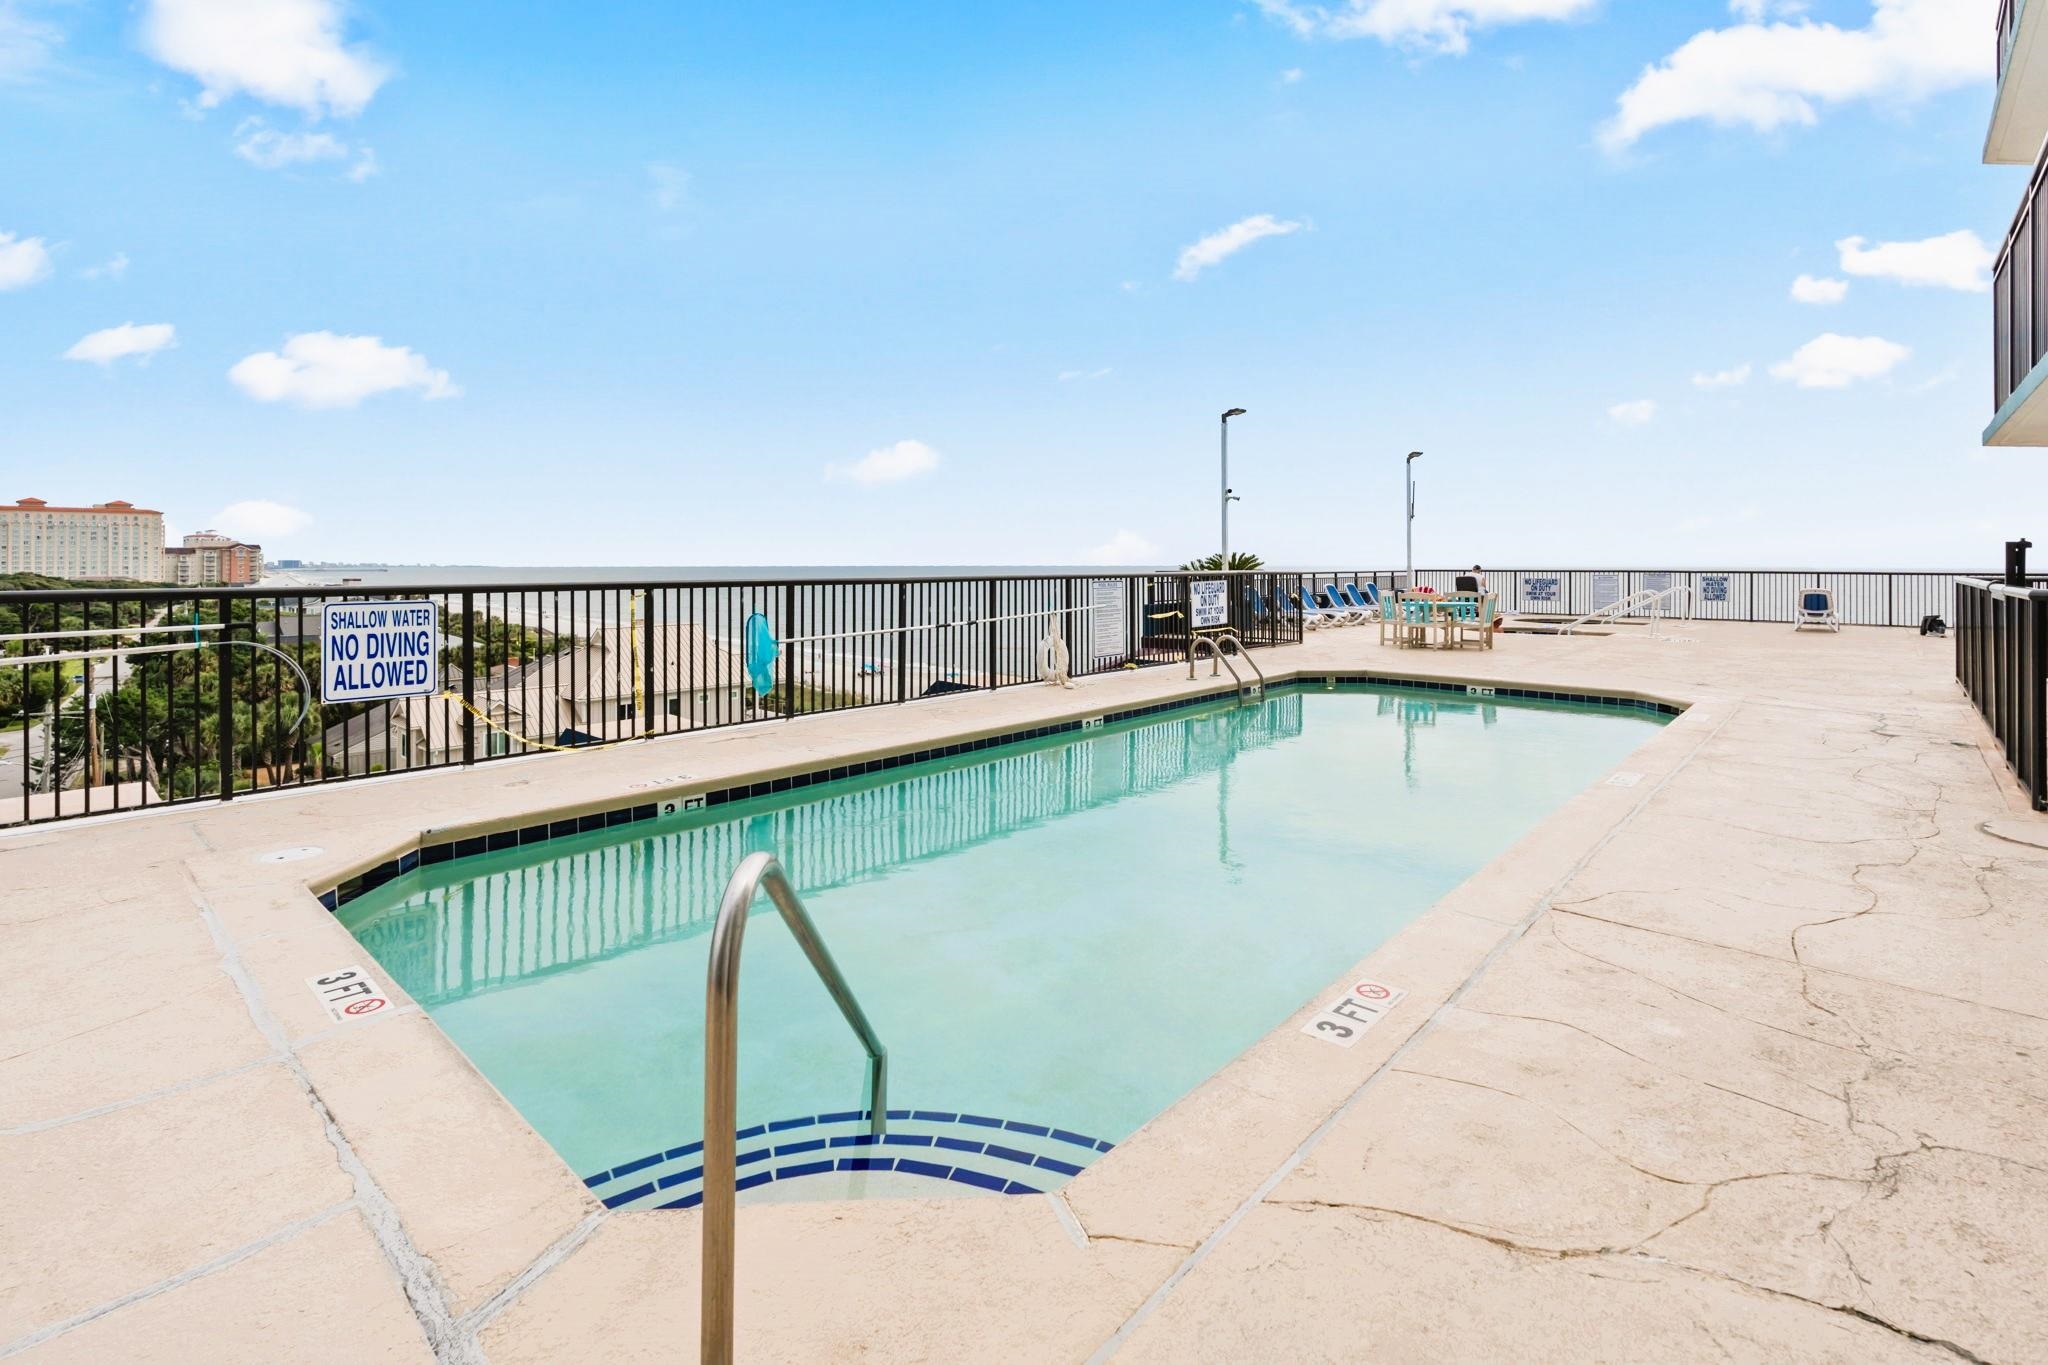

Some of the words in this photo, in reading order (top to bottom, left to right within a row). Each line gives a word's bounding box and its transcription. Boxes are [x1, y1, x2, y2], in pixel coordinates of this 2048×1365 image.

[1193, 582, 1200, 595] NO
[1201, 581, 1225, 594] LIFEGUARD
[1200, 595, 1207, 606] ON
[1208, 594, 1219, 606] DUTY
[331, 610, 387, 629] SHALLOW
[392, 609, 430, 626] WATER
[1195, 608, 1206, 616] SWIM
[1208, 607, 1213, 615] AT
[1214, 606, 1224, 614] YOUR
[1200, 616, 1210, 624] OWN
[1211, 615, 1220, 623] RISK
[331, 634, 359, 661] NO
[367, 631, 429, 659] DIVING
[333, 660, 428, 691] ALLOWED
[317, 972, 357, 985] 3
[323, 982, 372, 1002] FT
[1332, 998, 1378, 1023] FT
[1316, 1021, 1354, 1038] 3
